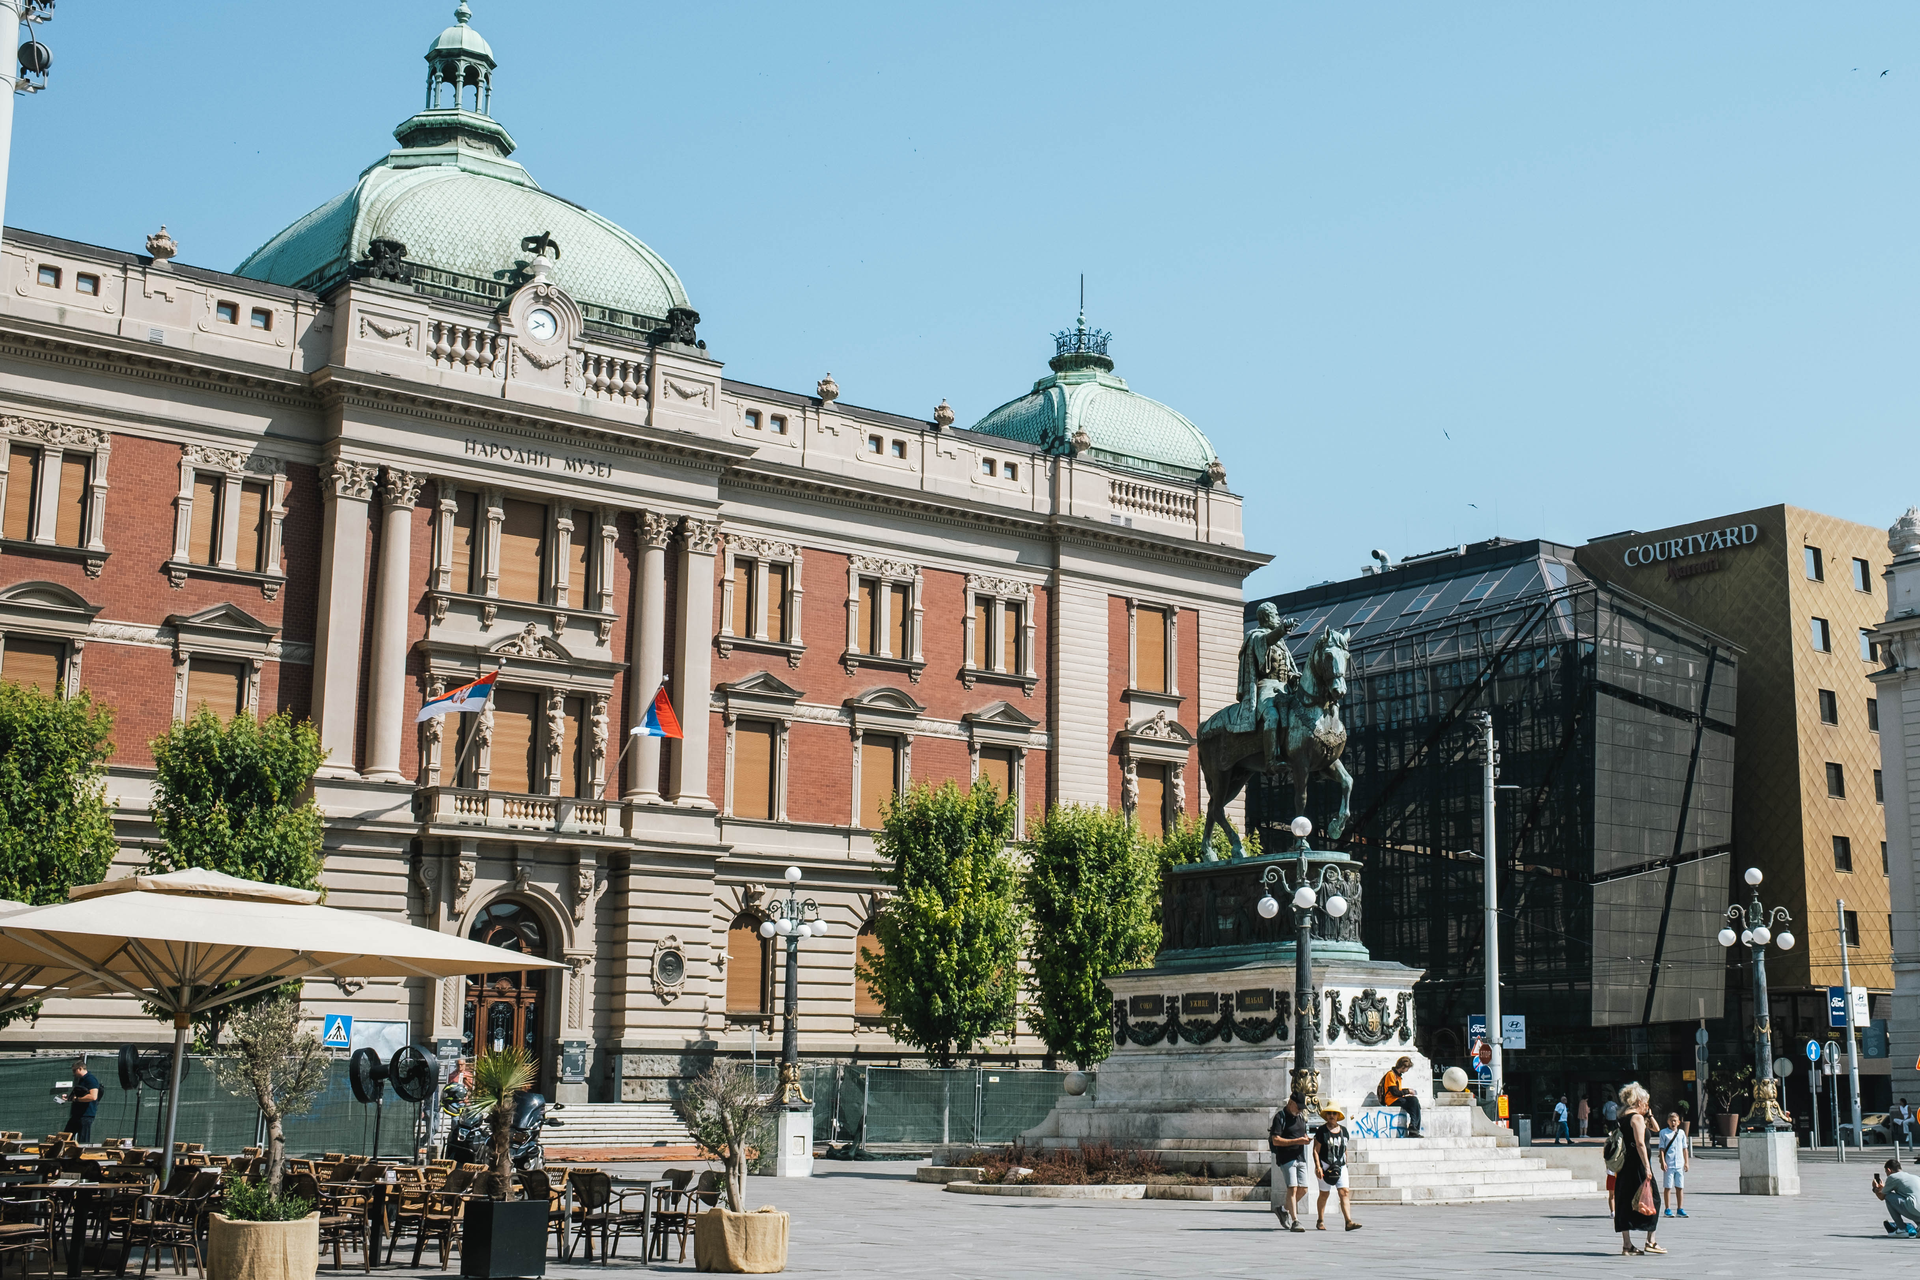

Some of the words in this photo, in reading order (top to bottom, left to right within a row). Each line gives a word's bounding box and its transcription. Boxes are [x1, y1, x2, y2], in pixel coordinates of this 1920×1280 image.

[465, 439, 551, 468] НАРОДНИ
[563, 457, 612, 478] МУЗЕЈ
[1624, 524, 1758, 566] COURTYARD
[1831, 997, 1844, 1007] Ford
[1480, 1050, 1491, 1058] STOP
